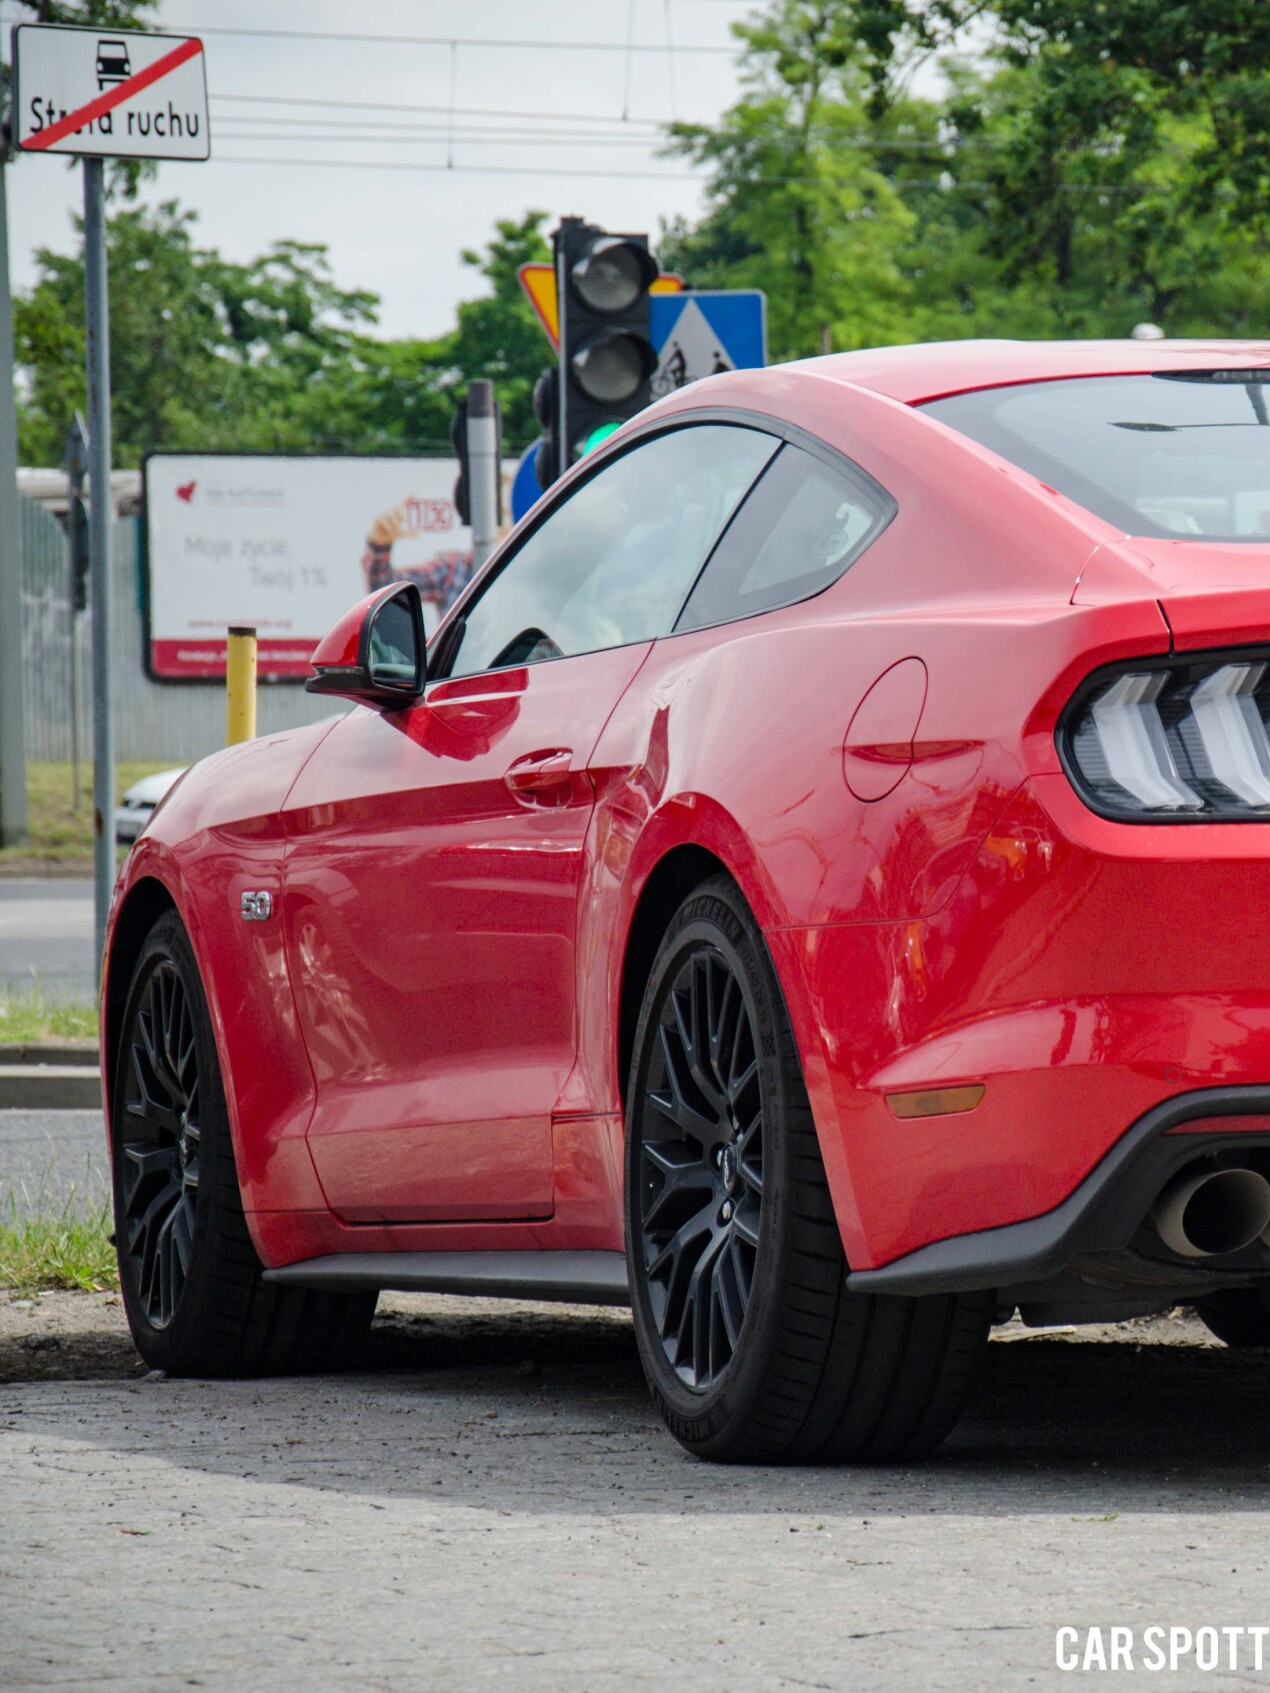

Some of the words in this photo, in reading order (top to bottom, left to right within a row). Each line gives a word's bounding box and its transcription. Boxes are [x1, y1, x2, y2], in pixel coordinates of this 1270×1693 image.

[127, 101, 199, 137] ruchu
[183, 534, 232, 562] Moje
[249, 565, 294, 594] Twój
